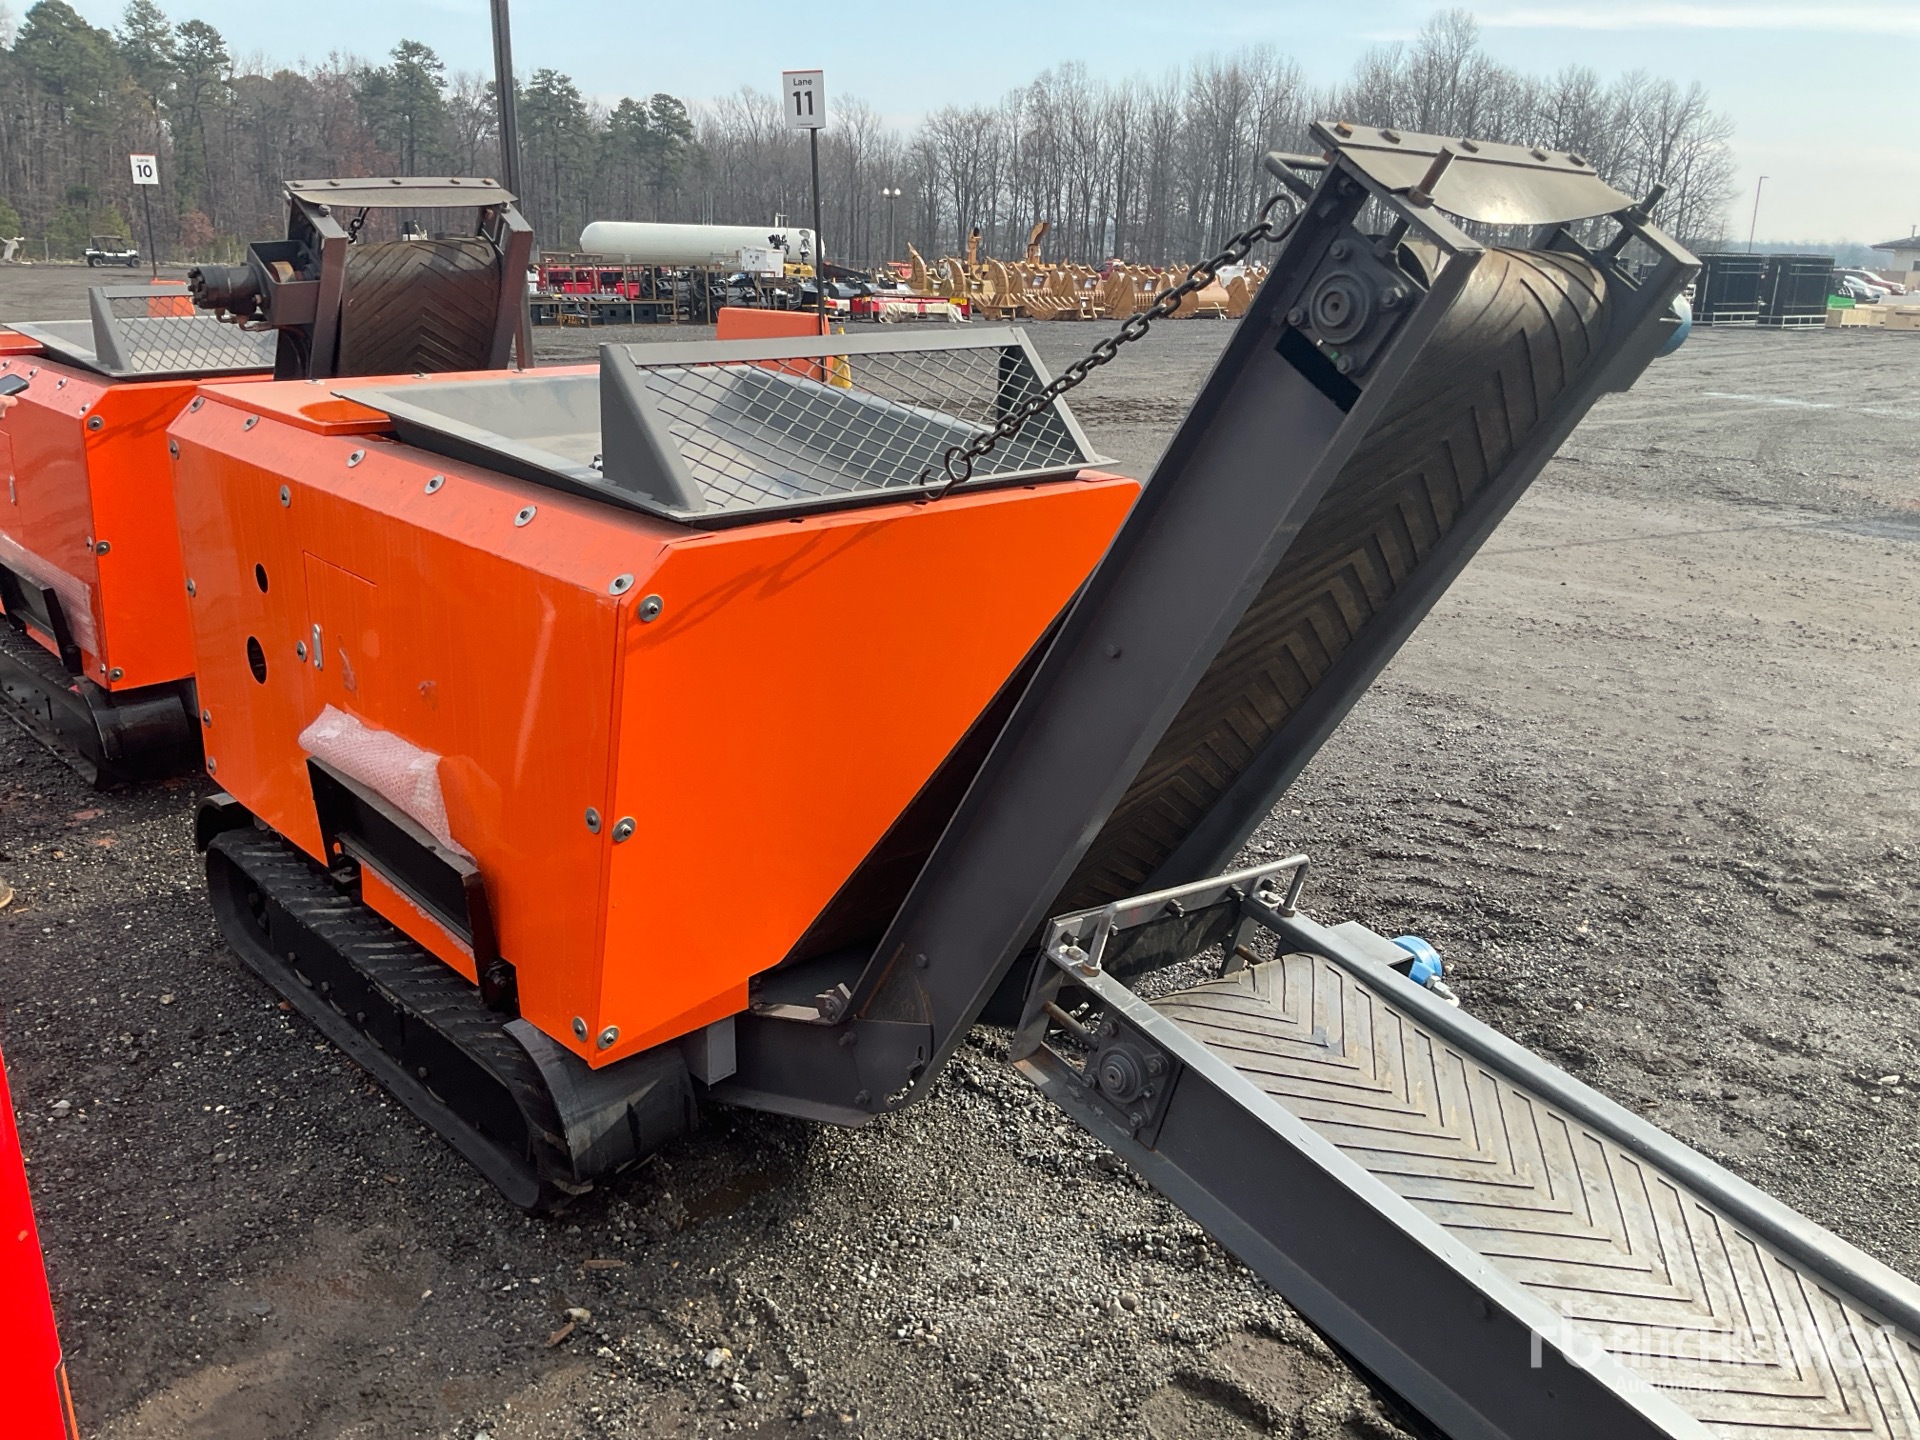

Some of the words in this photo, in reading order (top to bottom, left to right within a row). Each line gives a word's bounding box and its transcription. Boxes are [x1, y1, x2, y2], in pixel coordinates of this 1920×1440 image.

[792, 78, 813, 86] Lane
[792, 90, 813, 116] 11
[136, 164, 153, 178] 10
